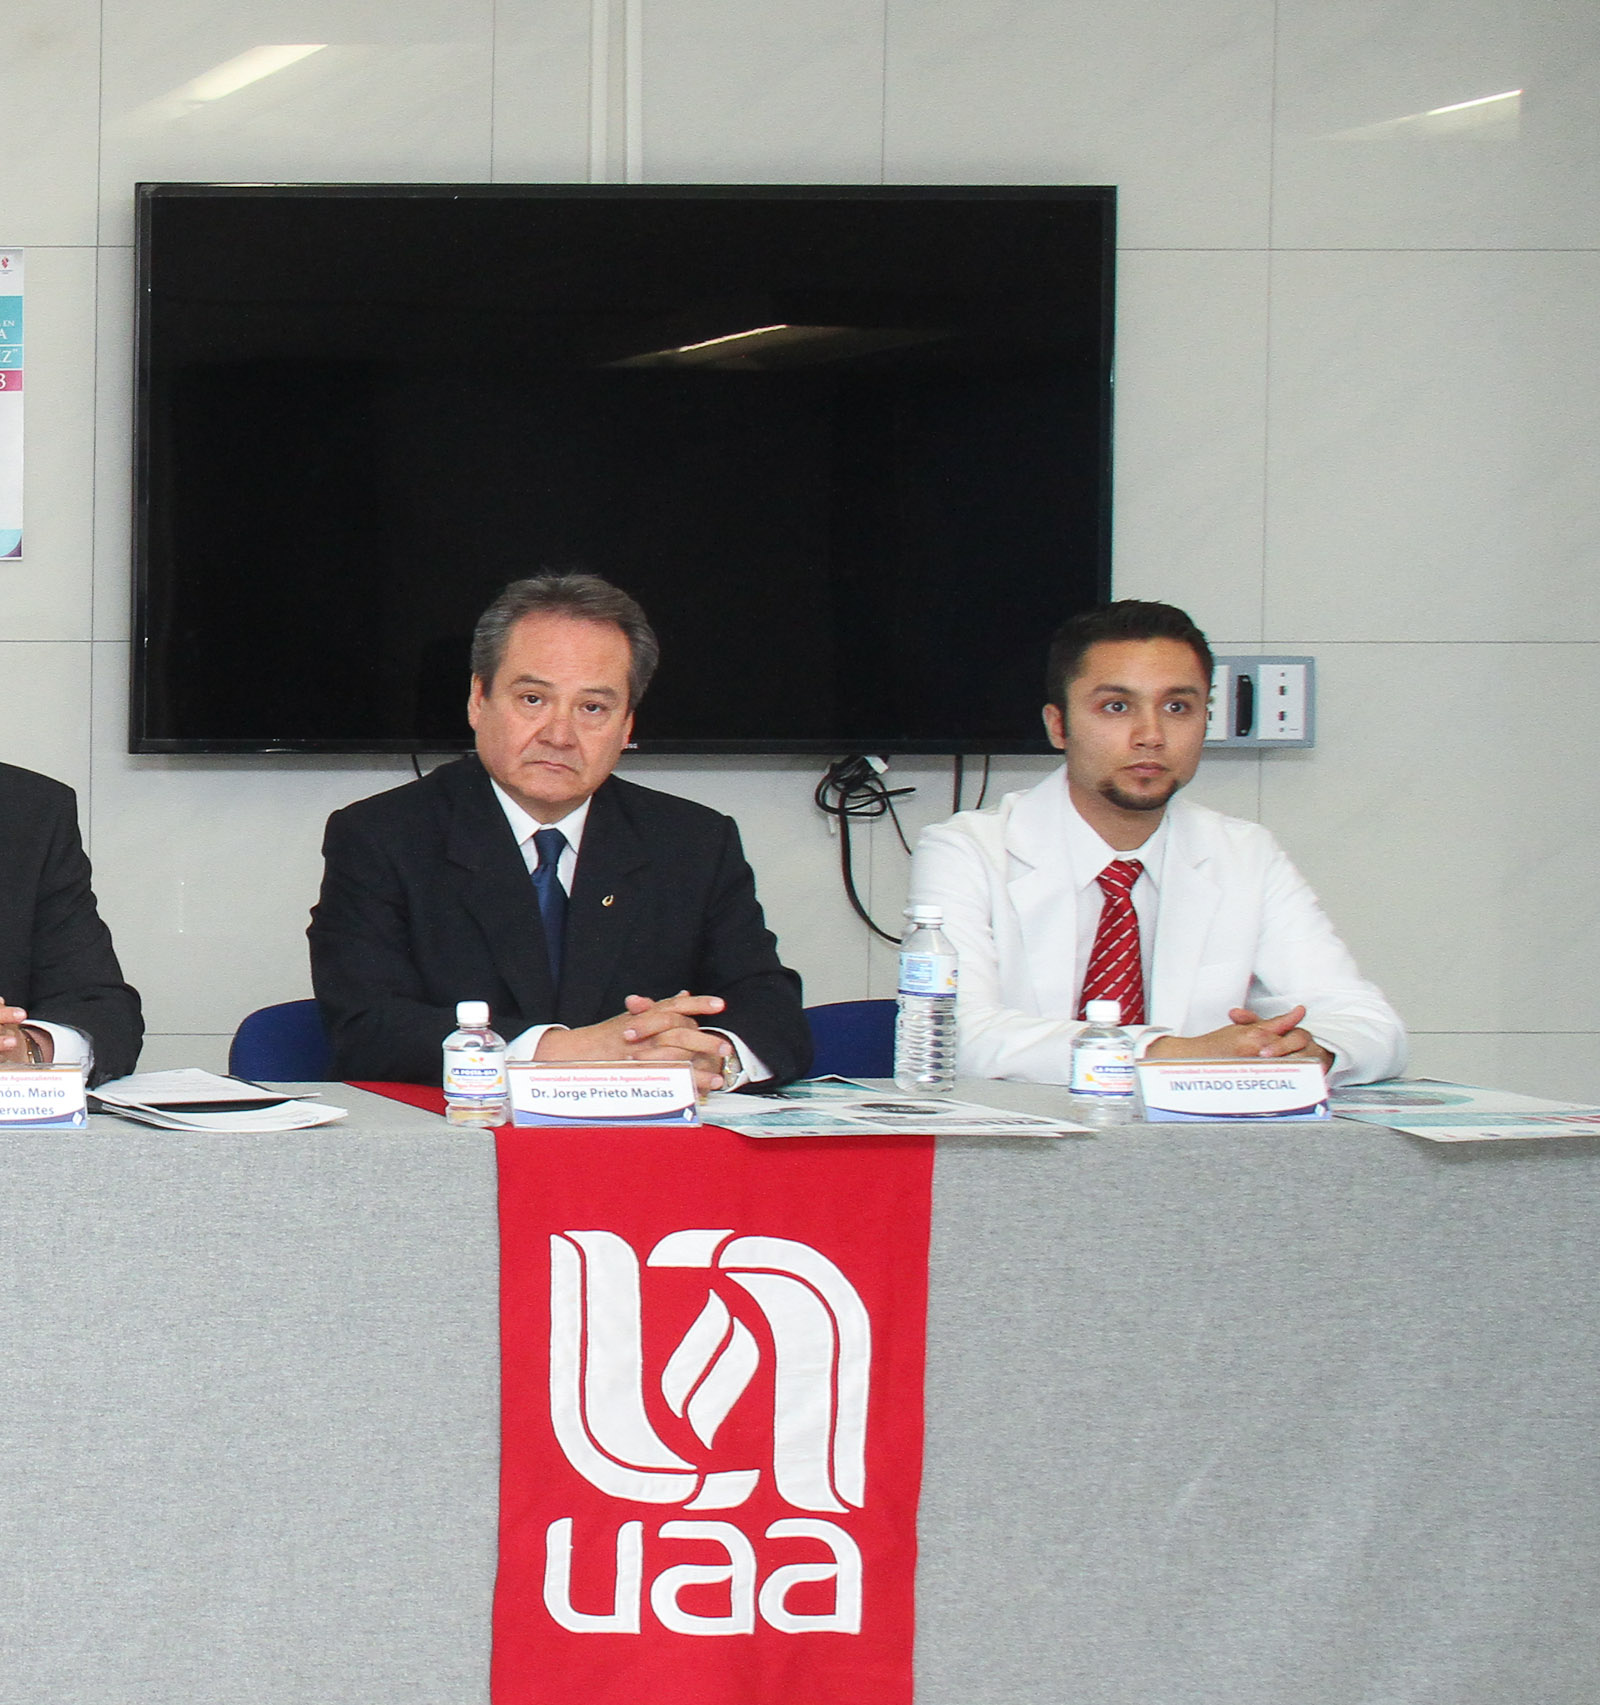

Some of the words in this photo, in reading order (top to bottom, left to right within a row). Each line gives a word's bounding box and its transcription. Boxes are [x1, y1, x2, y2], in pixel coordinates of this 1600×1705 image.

[1170, 1080, 1234, 1091] INVITADO
[1237, 1079, 1296, 1090] ESPECIAL
[28, 1087, 65, 1098] Mario
[531, 1088, 549, 1098] Dr.
[553, 1088, 587, 1101] Jorge
[590, 1088, 628, 1098] Prieto
[543, 1517, 863, 1635] uaa
